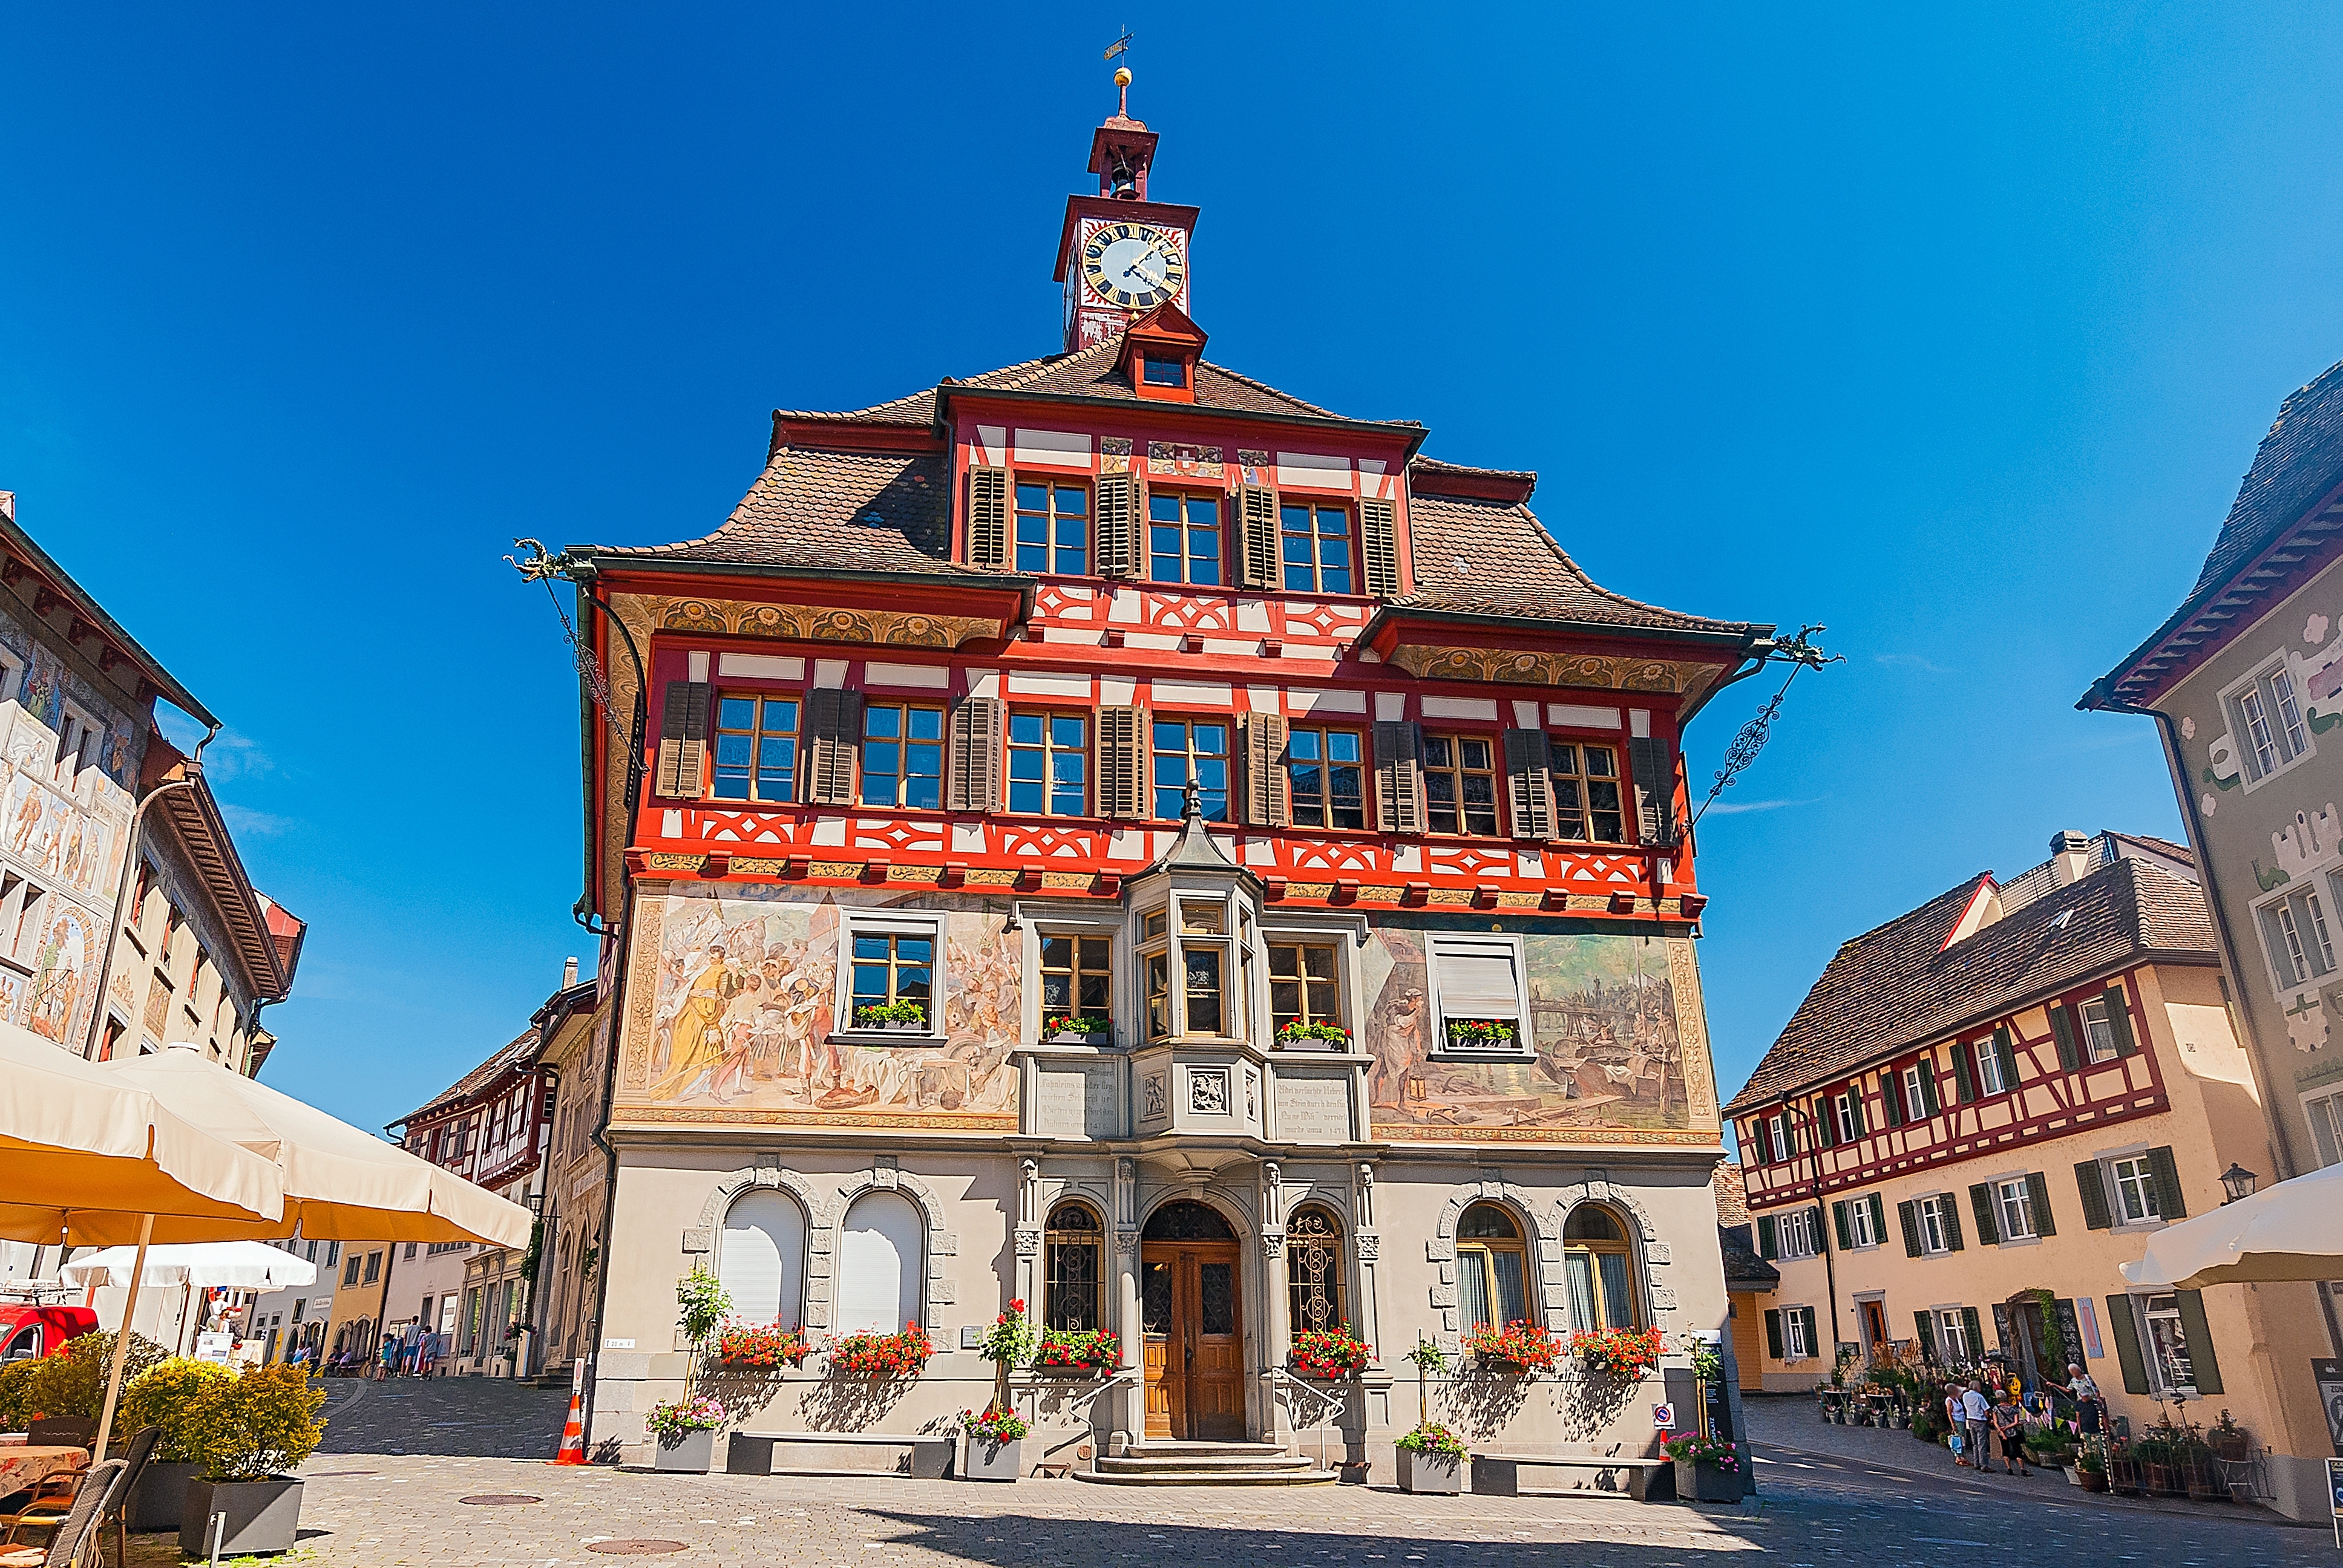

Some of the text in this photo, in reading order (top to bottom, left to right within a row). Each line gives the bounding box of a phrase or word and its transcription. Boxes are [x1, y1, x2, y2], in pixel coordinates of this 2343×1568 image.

[1106, 227, 1121, 244] XI
[1127, 225, 1140, 240] XII
[1090, 239, 1108, 252] X
[1085, 257, 1101, 266] IX
[1167, 265, 1182, 275] III
[1160, 278, 1179, 294] IIII
[1105, 286, 1120, 302] VII
[1129, 293, 1140, 306] VI
[1150, 291, 1164, 305] V
[1289, 1098, 1306, 1108] Stein
